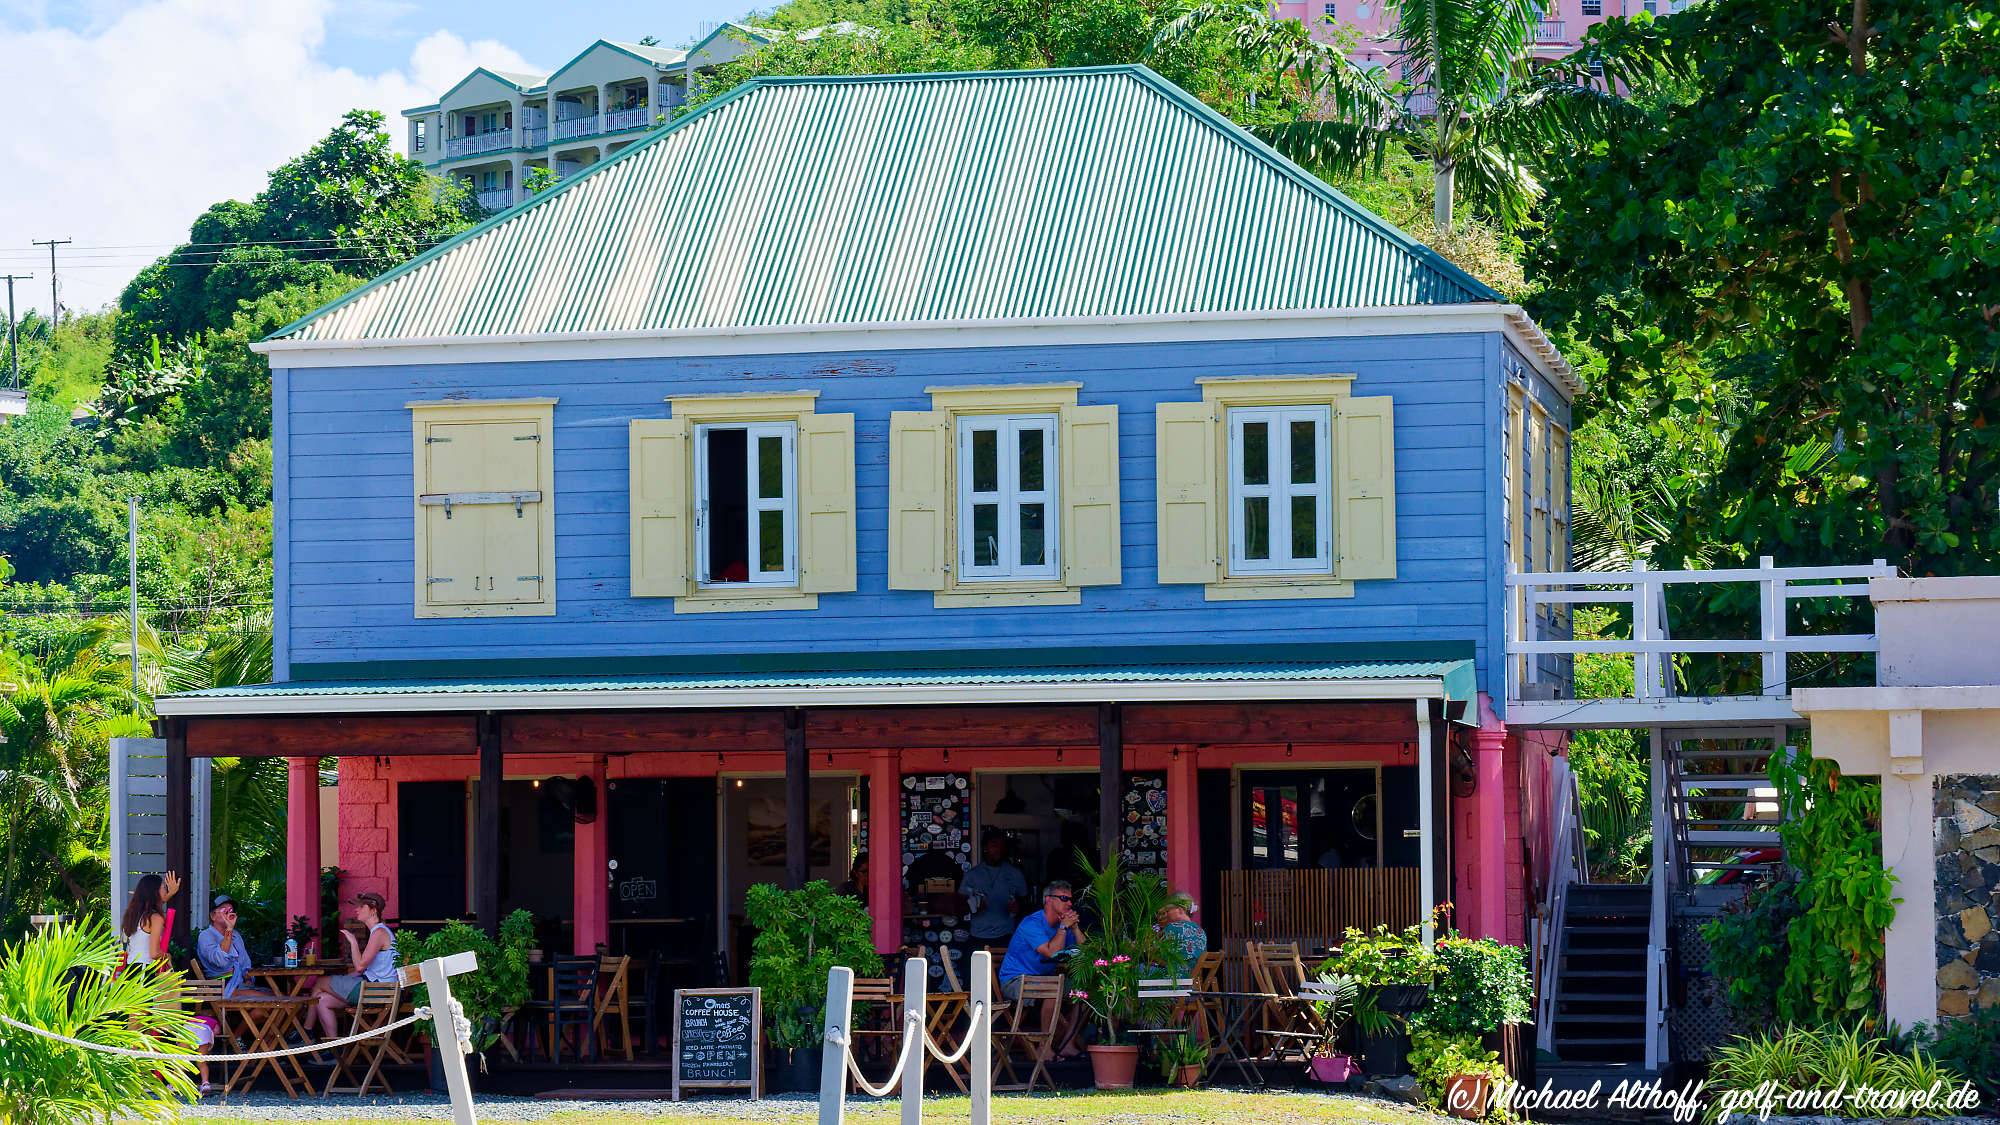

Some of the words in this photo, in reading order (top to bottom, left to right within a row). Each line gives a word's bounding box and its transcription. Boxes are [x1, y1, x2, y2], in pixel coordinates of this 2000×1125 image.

[622, 884, 653, 897] OPEN
[713, 1009, 740, 1017] HOUSE
[695, 1051, 736, 1060] OPEN
[687, 1069, 736, 1078] BRUNCH
